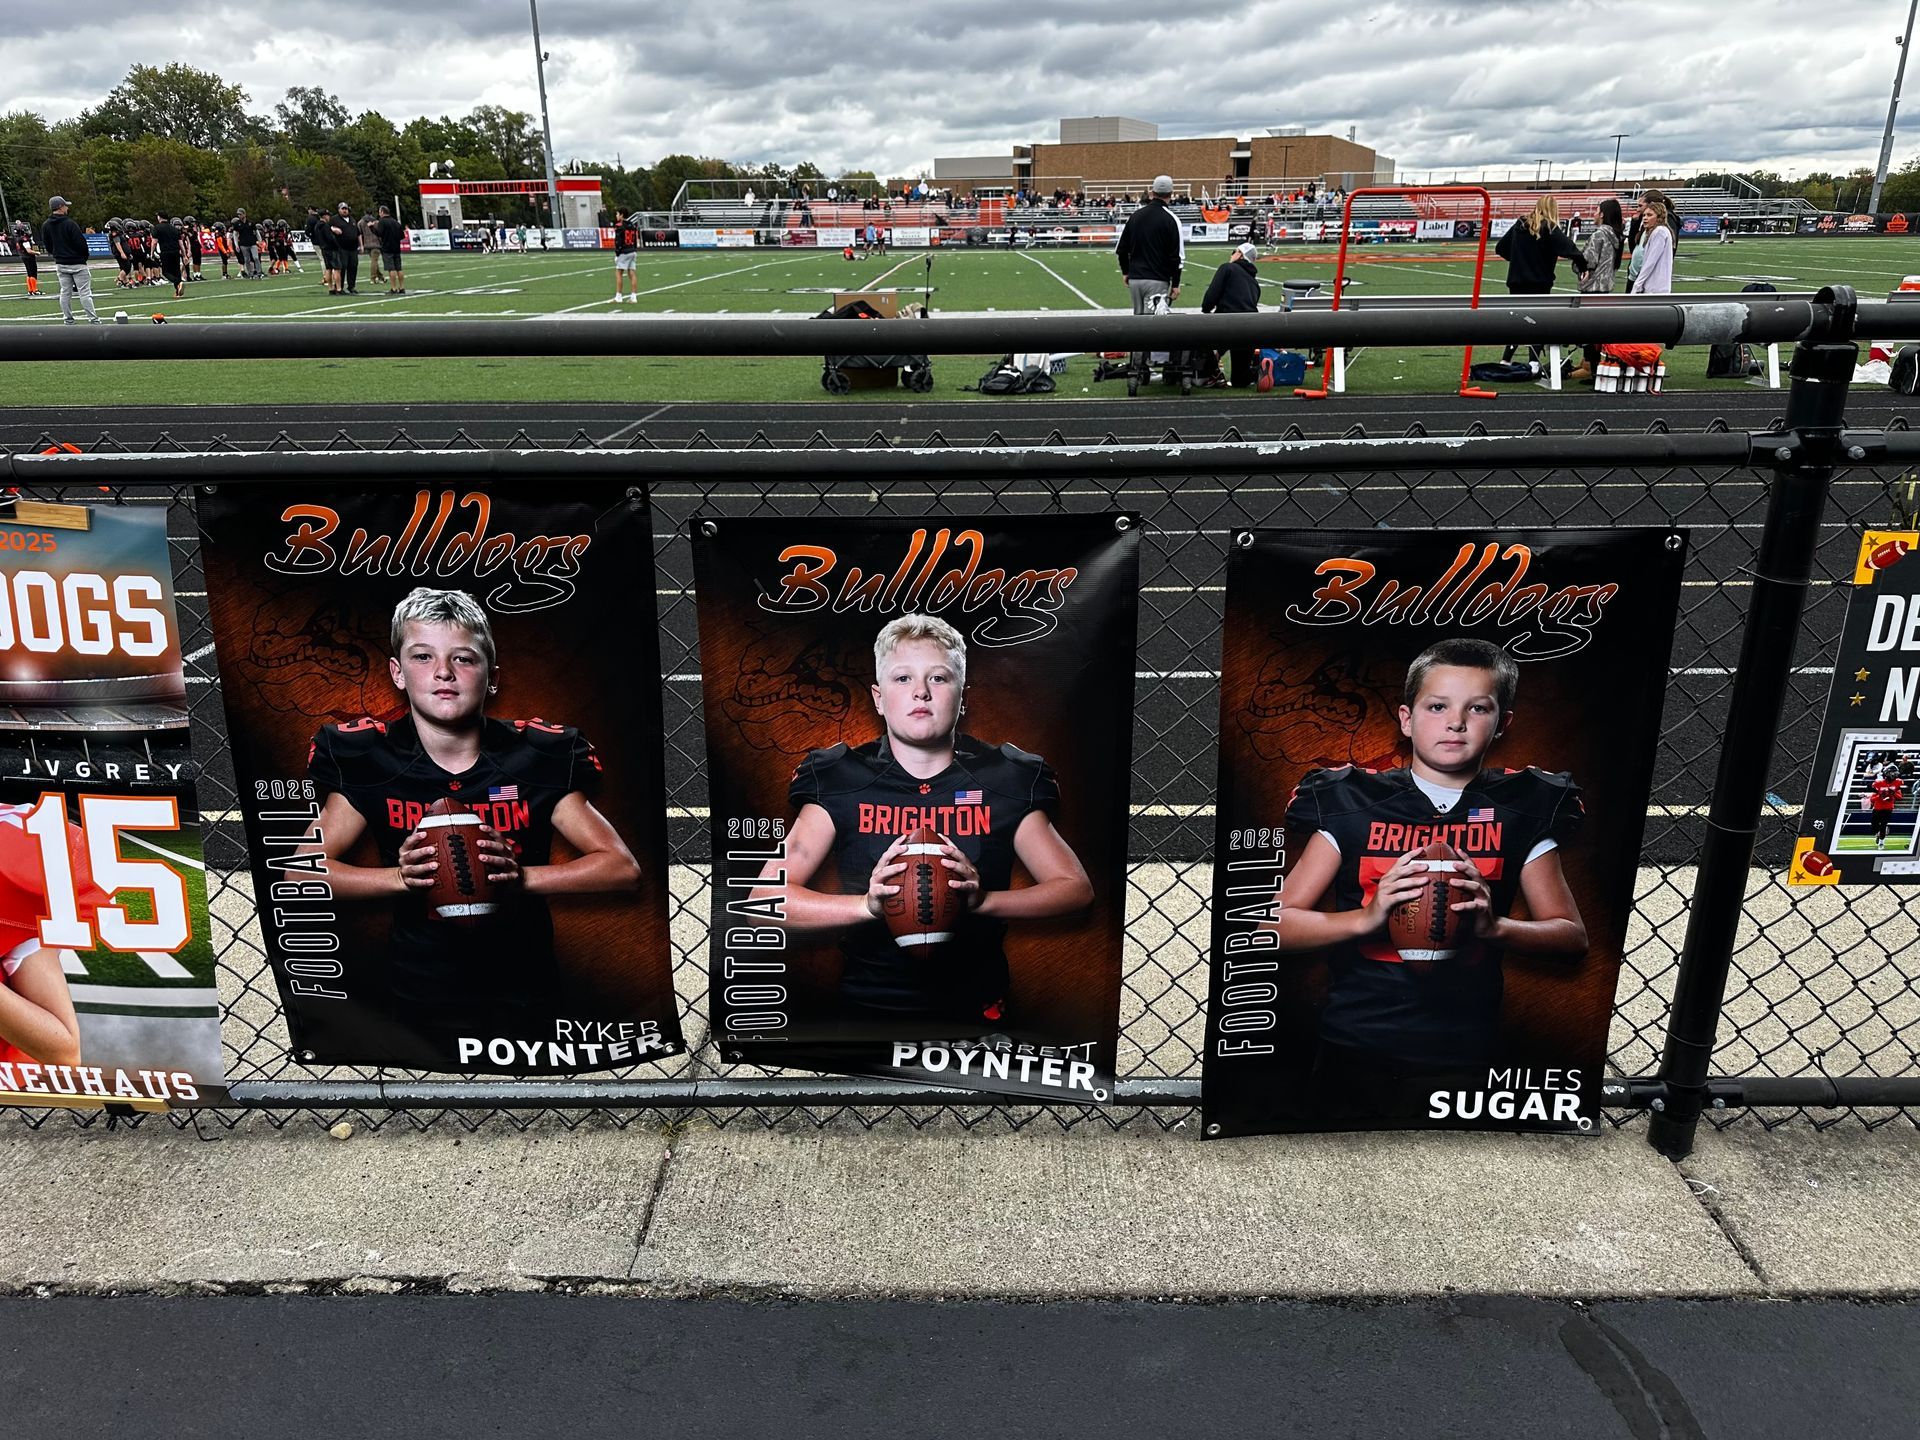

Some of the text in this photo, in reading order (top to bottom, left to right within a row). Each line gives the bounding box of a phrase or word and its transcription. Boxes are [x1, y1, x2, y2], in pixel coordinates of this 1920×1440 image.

[524, 181, 548, 192] COUN
[1423, 221, 1449, 230] Label
[264, 490, 591, 614] Bulldogs
[757, 528, 1078, 647] Bulldogs
[1286, 542, 1619, 662] Bulldogs
[0, 570, 168, 656] OGS
[1879, 667, 1920, 721] N
[255, 779, 317, 800] 2025
[387, 798, 530, 832] BRTON
[727, 818, 785, 839] 2025
[858, 803, 991, 836] BRIGHTON
[1230, 828, 1285, 850] 2025
[1367, 821, 1503, 852] BRIGHTON
[24, 792, 193, 952] 15
[258, 802, 348, 999] FOOTBALL
[1407, 898, 1421, 934] ilson
[1218, 850, 1285, 1057] FOOTBALL
[555, 1019, 659, 1041] RYKER
[458, 1032, 664, 1066] POYNTER
[952, 1042, 1098, 1062] BARRETT
[0, 1061, 199, 1100] NEUHAUS
[892, 1043, 1095, 1091] POYNTER
[1487, 1068, 1582, 1092] MILES
[1428, 1092, 1581, 1121] SUGAR
